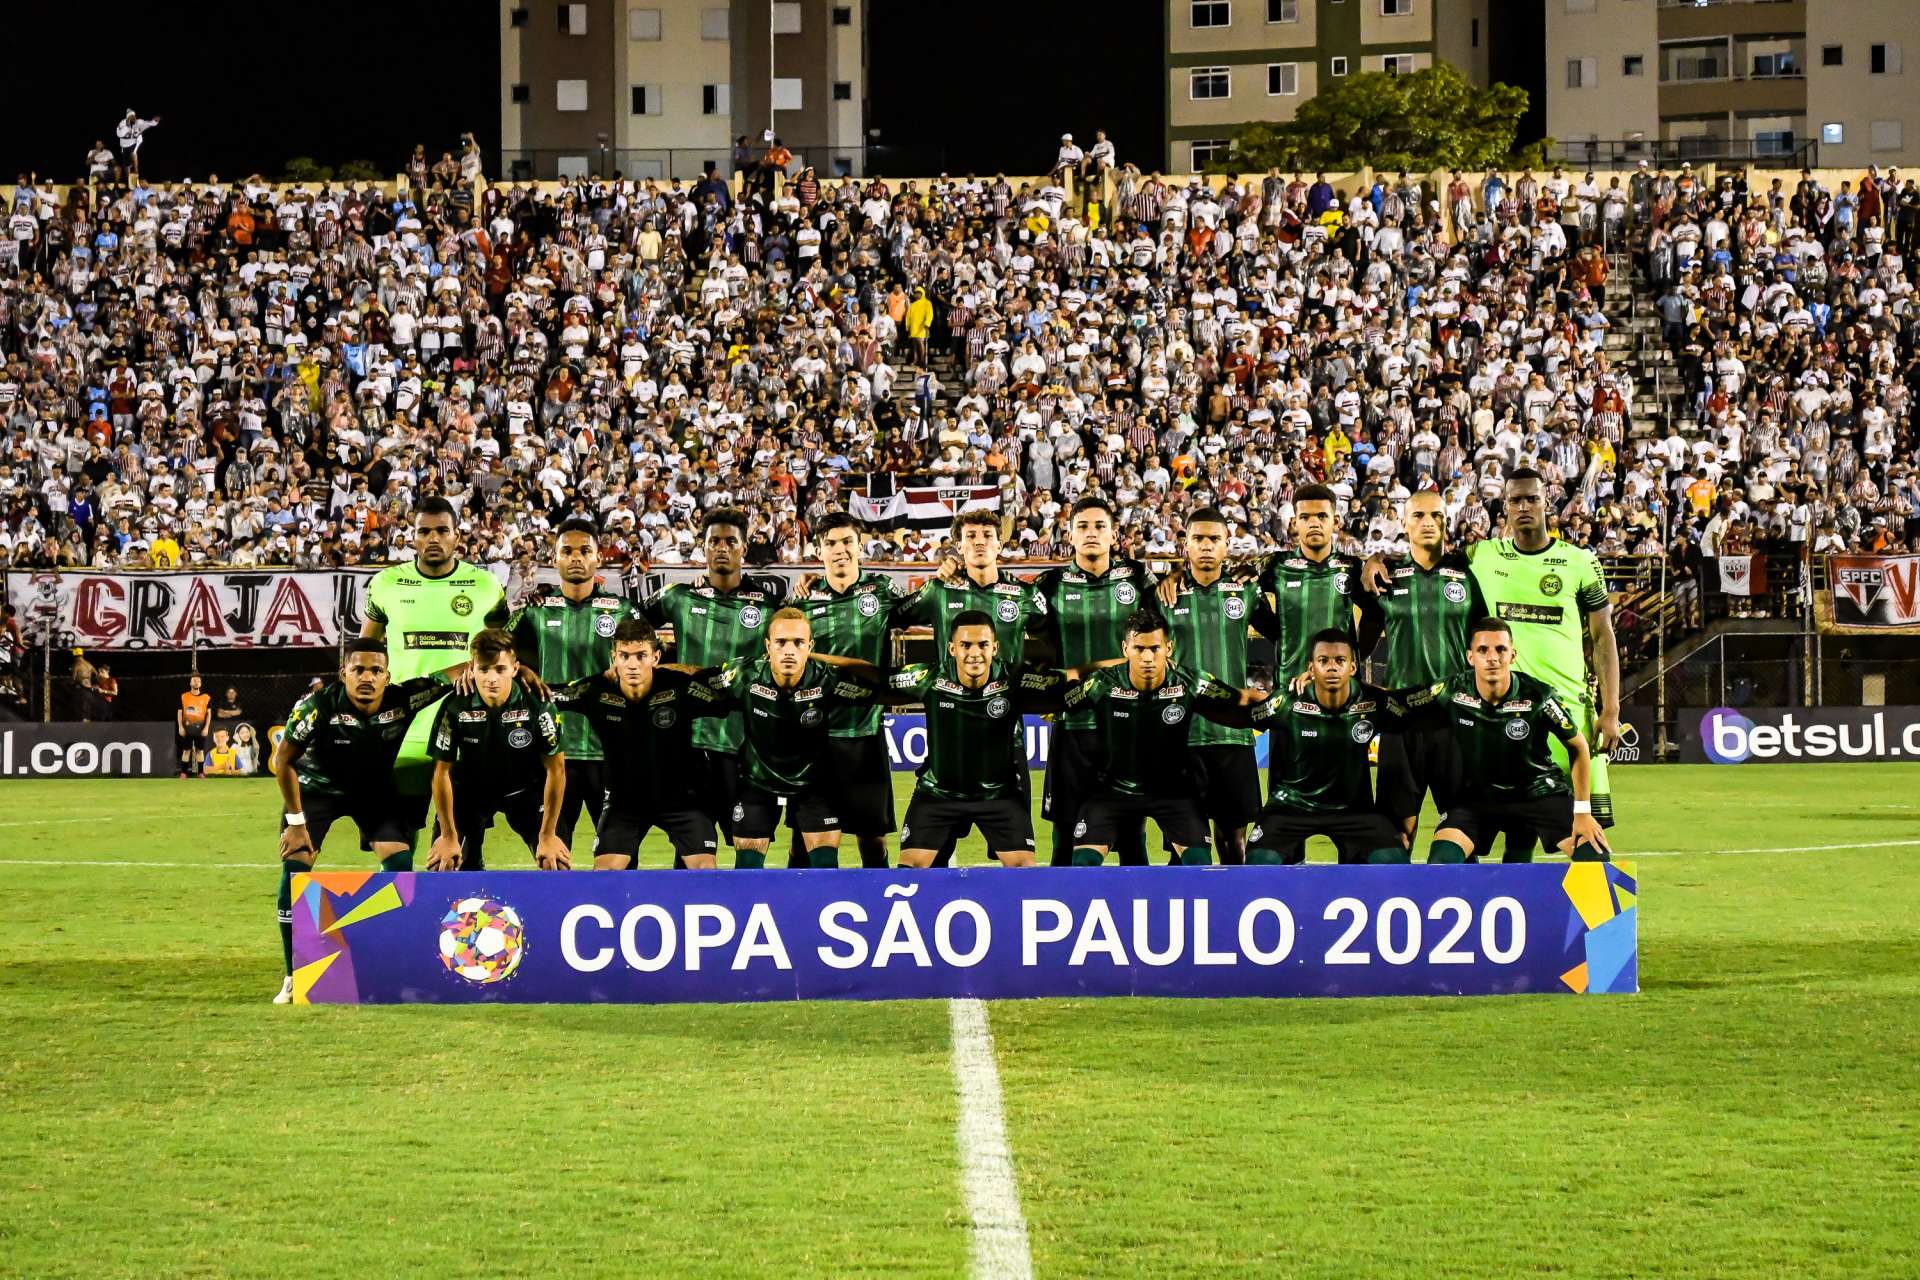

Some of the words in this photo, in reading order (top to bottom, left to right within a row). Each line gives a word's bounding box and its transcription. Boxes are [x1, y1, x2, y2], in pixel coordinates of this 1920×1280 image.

[940, 489, 969, 498] SPFC
[1841, 571, 1882, 583] SPFC
[1021, 673, 1042, 682] PRO
[836, 681, 856, 691] PRO
[889, 680, 918, 689] TORK
[1020, 680, 1048, 691] TORK
[759, 686, 777, 697] RDP
[939, 701, 955, 709] 1909
[753, 708, 768, 717] 1909
[1458, 718, 1475, 727] 1909
[560, 903, 793, 972] COPA
[817, 883, 991, 969] SÃO
[1022, 897, 1295, 966] PAULO
[1323, 896, 1526, 964] 2020
